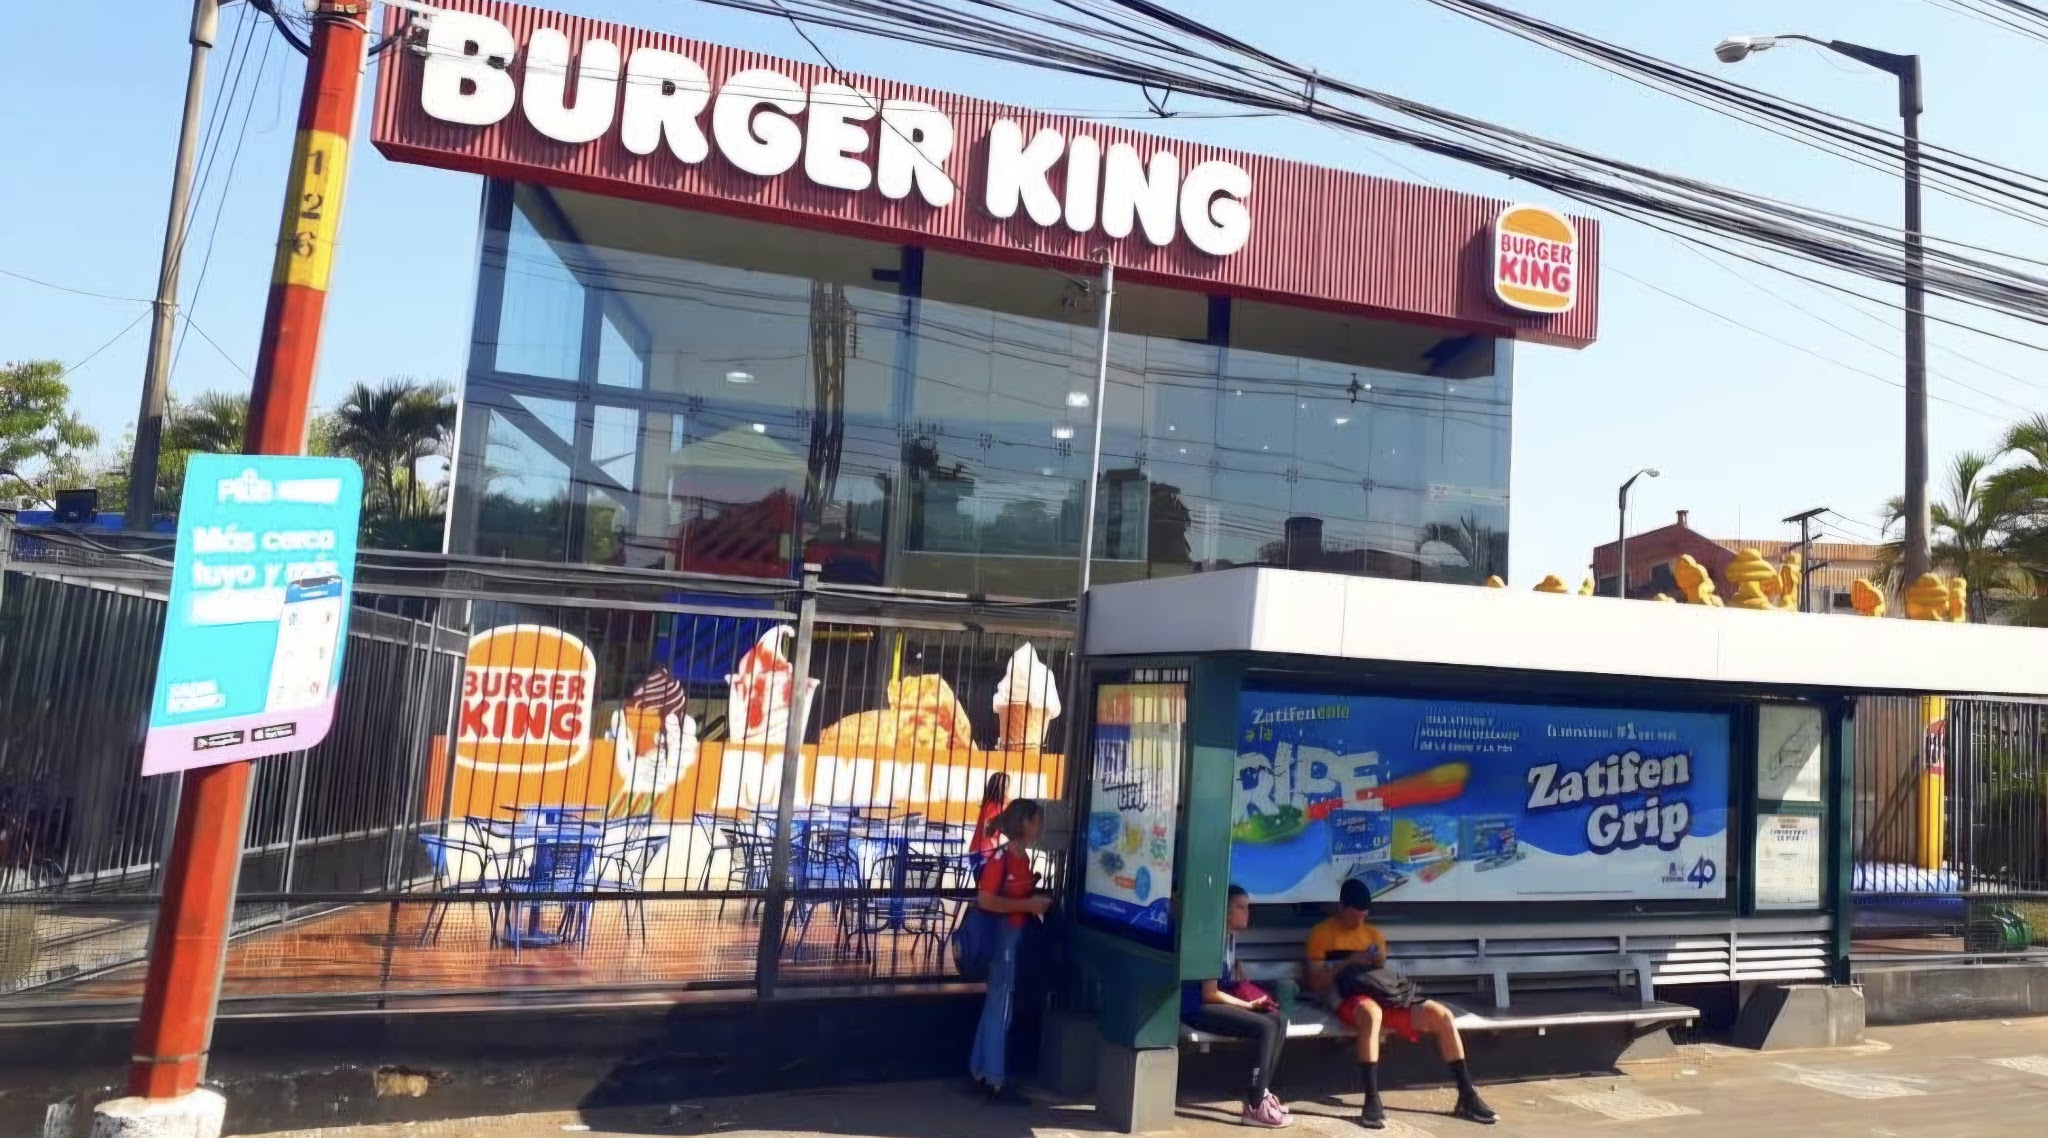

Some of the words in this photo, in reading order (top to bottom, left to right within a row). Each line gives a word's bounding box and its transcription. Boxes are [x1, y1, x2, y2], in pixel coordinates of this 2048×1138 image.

[421, 9, 954, 207] BURGER
[986, 116, 1252, 256] KING
[1501, 234, 1573, 265] BURGER
[1500, 254, 1571, 293] KING
[464, 671, 586, 700] BURGER
[460, 701, 583, 741] KING
[1526, 751, 1690, 810] Zatifen
[1587, 796, 1689, 847] Grip
